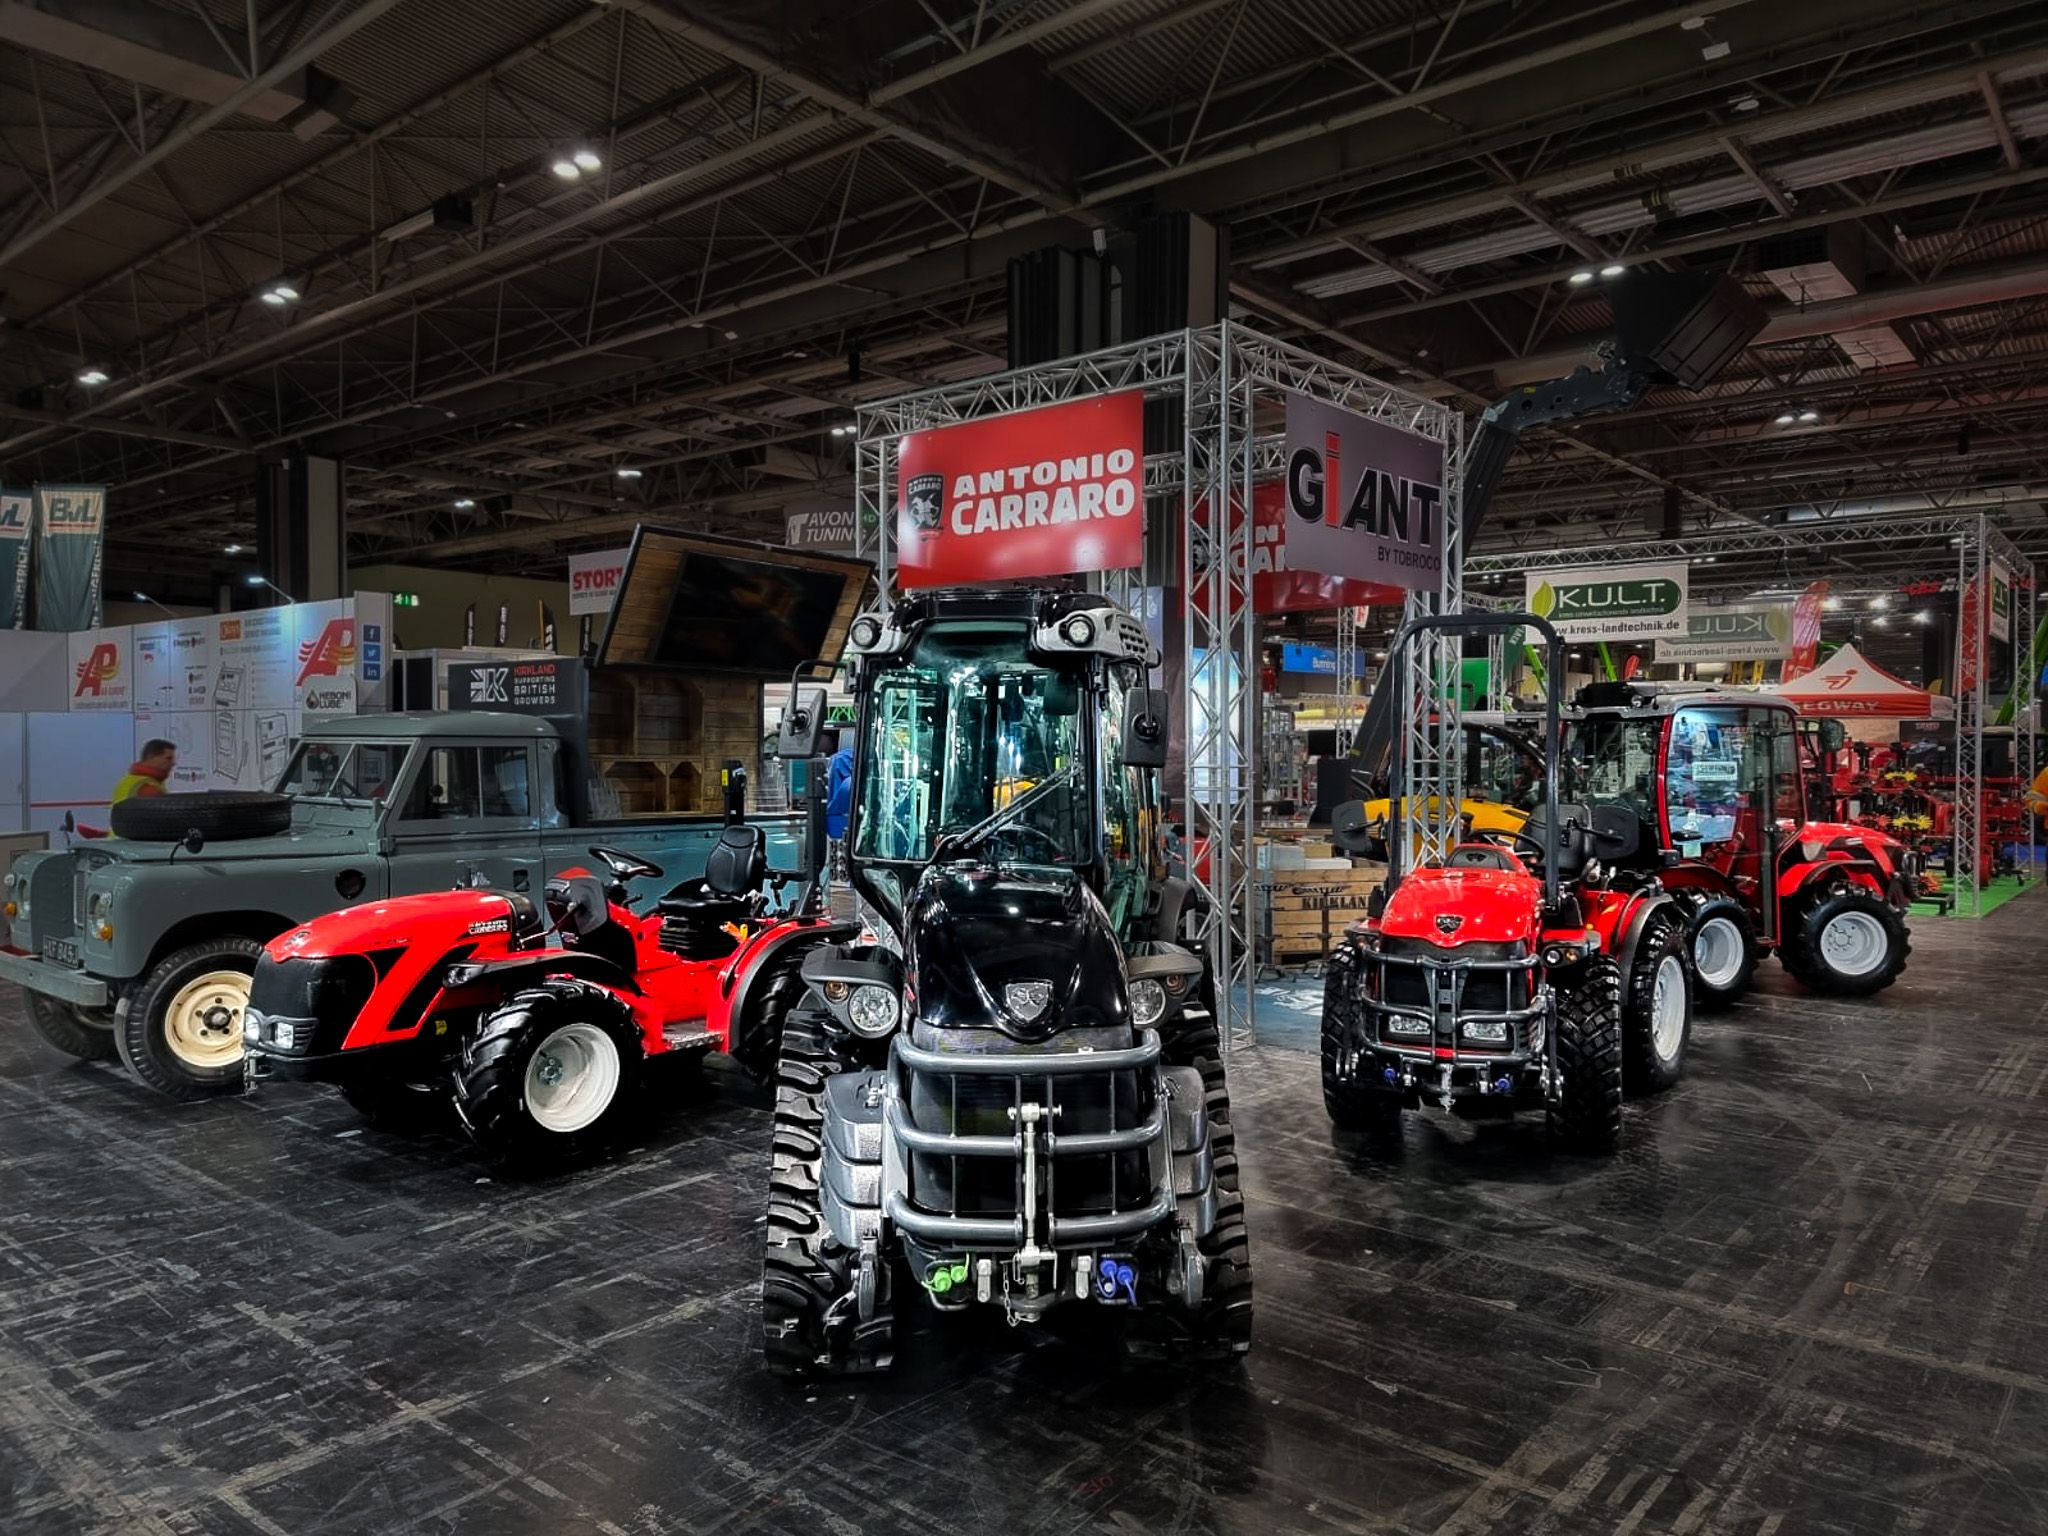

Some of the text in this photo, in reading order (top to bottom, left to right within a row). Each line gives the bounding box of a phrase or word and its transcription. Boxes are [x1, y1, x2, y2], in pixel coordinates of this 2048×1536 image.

[953, 448, 1134, 498] ANTONIO
[1288, 431, 1442, 547] GiANT
[951, 478, 1135, 536] CARRARO
[808, 511, 855, 527] AVON
[805, 526, 867, 543] TUNING
[1377, 546, 1442, 571] BY TOBROCO
[1559, 583, 1666, 608] K.U.L.T.
[1555, 621, 1679, 635] w.kress-landtechnik.de
[514, 664, 556, 676] KIRKLAND
[514, 676, 556, 684] SUPPORTING
[514, 684, 556, 695] BRITISH
[514, 696, 555, 705] GROWERS
